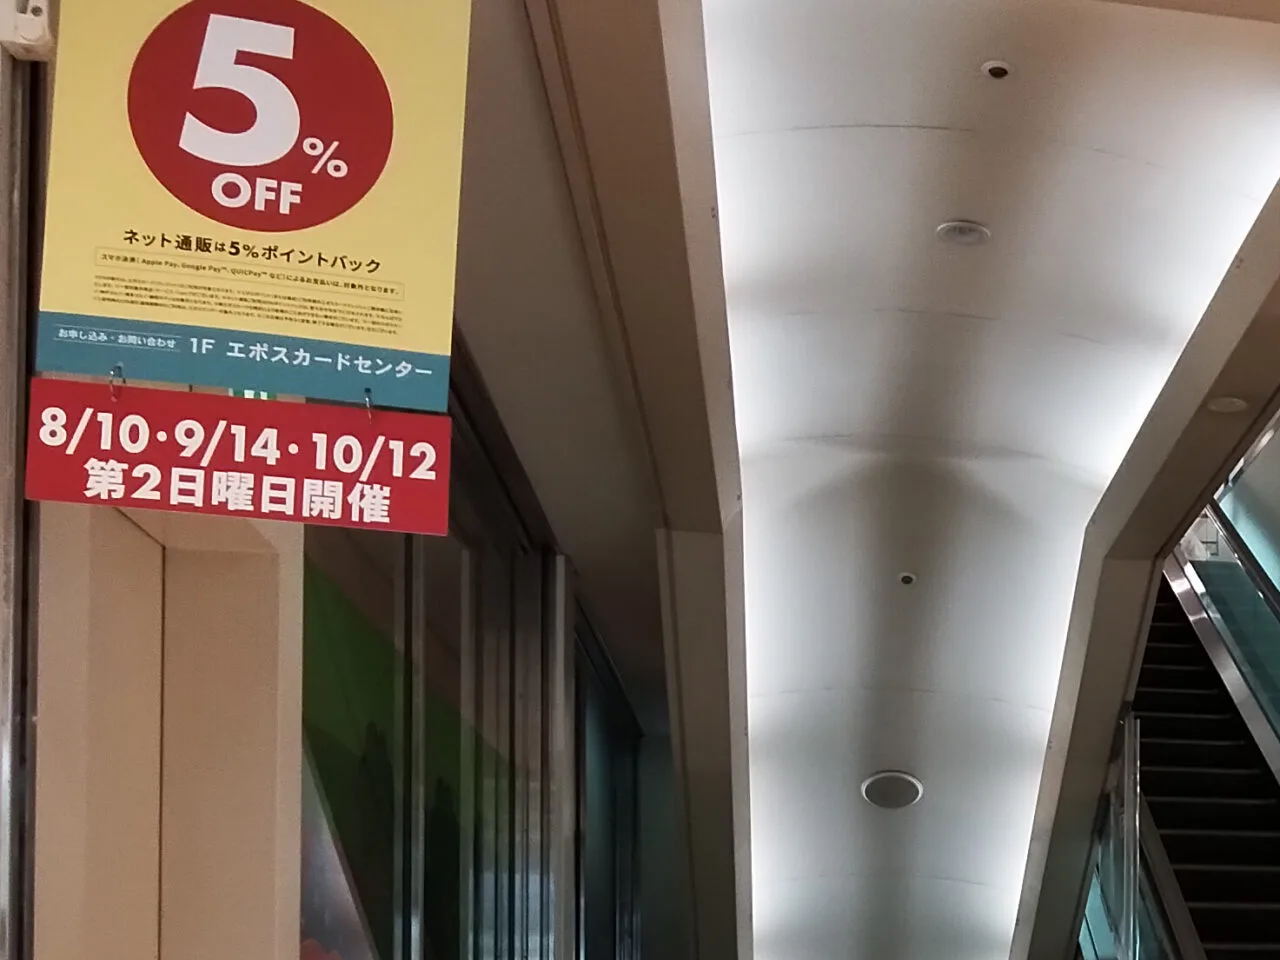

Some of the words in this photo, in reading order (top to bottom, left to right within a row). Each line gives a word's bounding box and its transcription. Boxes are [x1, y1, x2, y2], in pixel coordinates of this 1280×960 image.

[211, 172, 302, 215] OFF
[123, 229, 381, 274] ネット通販は5%ポイントバック
[58, 328, 177, 349] お申し込み・お問い合わせ
[190, 336, 216, 355] 1F
[226, 341, 433, 378] エポスカードセンター
[83, 457, 391, 524] 第2日曜日開催
